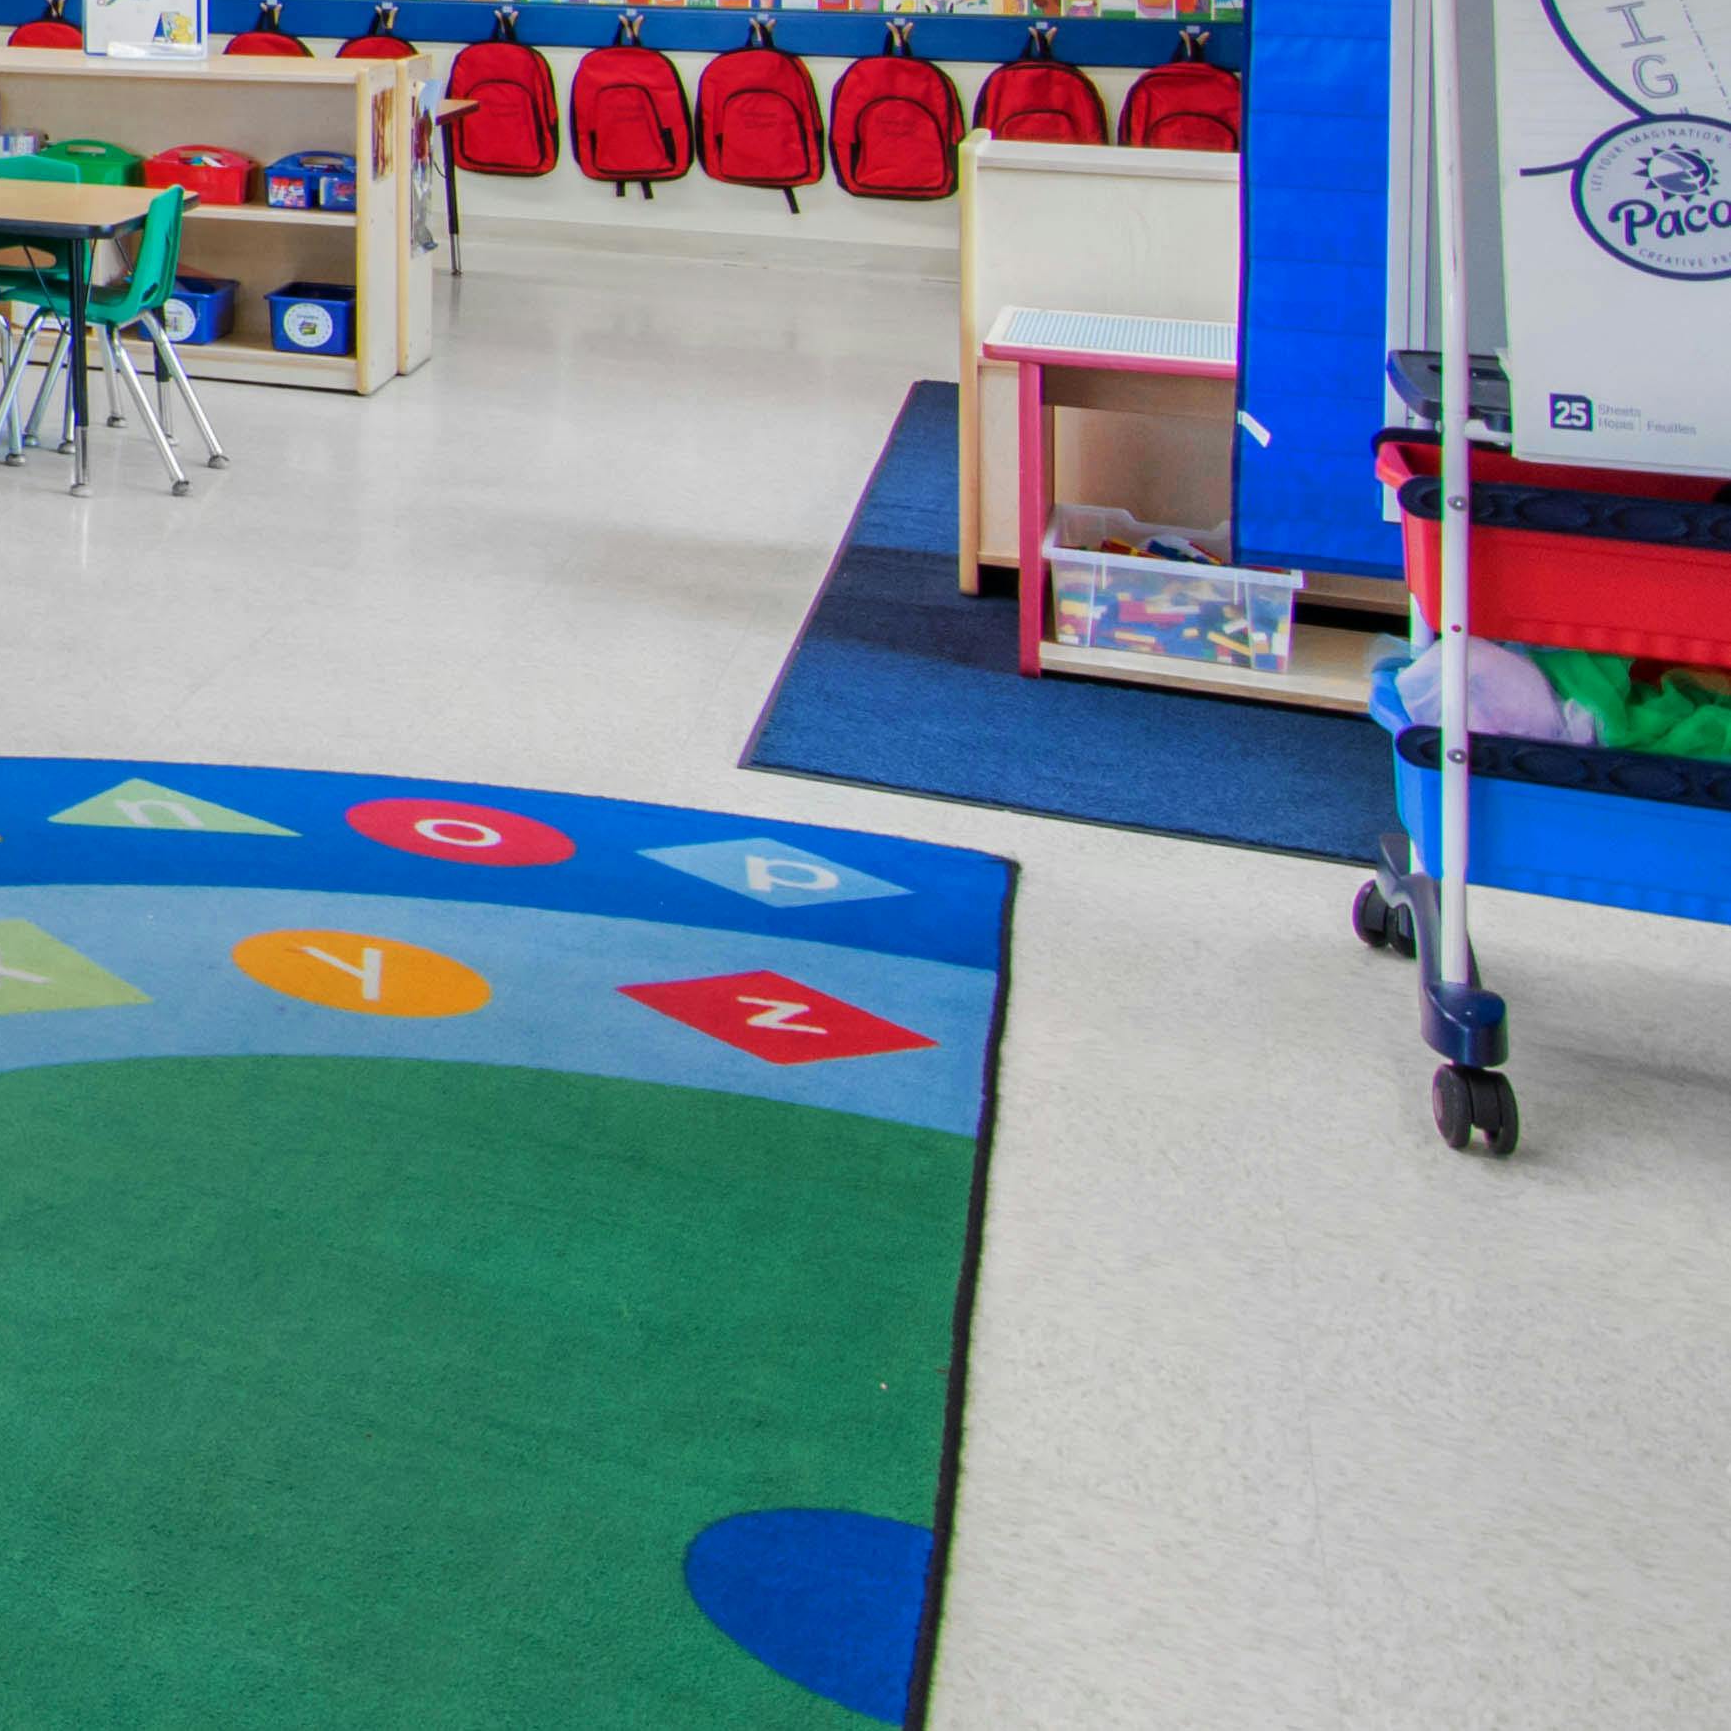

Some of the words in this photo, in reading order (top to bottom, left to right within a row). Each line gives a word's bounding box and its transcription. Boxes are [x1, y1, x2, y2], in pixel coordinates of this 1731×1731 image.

[1624, 127, 1724, 147] IMAGINATION
[1554, 400, 1588, 428] 25
[1597, 403, 1642, 418] Sheets
[113, 798, 205, 828] n
[413, 818, 503, 848] o
[745, 854, 840, 893] p
[301, 947, 384, 1001] y
[738, 995, 829, 1035] z
